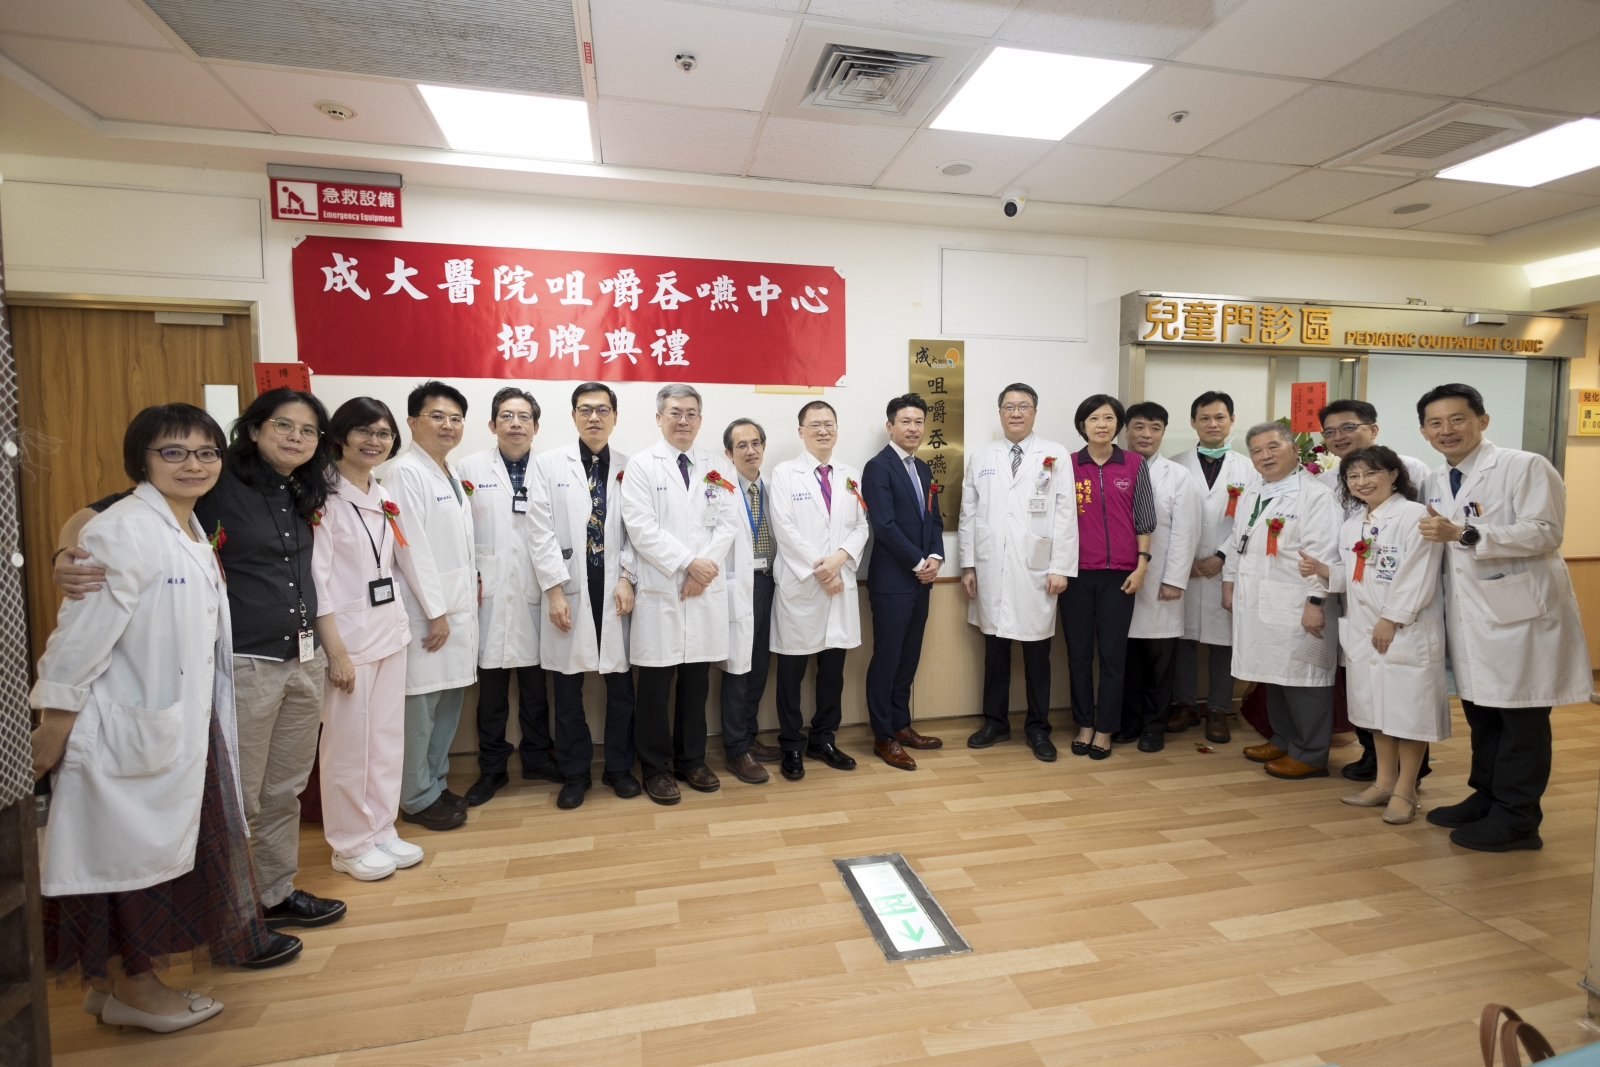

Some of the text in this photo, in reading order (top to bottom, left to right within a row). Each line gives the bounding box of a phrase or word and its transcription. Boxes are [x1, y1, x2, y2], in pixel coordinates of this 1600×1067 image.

[322, 187, 395, 208] 急救設備
[323, 210, 395, 223] Emergency Equipment
[319, 252, 829, 317] 成大醫院咀嚼吞嚥中心
[496, 322, 691, 367] 揭牌典禮
[1143, 300, 1334, 345] 兒童門診區
[1344, 331, 1544, 353] PEDIATRIC OUTPATIENT CLINIC
[927, 376, 948, 517] 咀嚼吞嚥中
